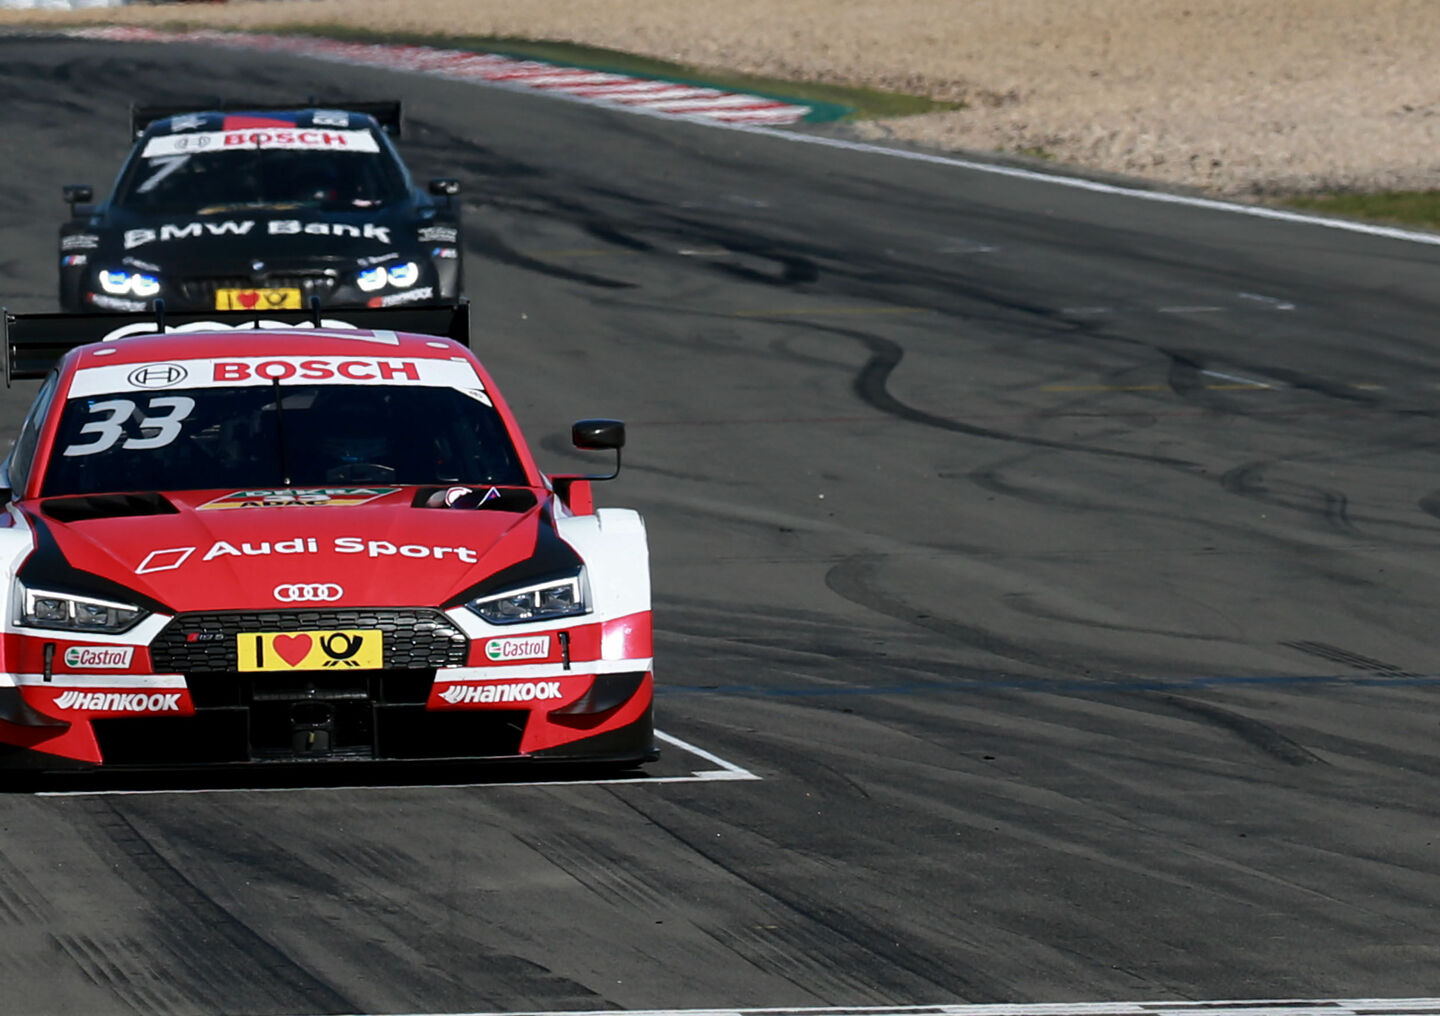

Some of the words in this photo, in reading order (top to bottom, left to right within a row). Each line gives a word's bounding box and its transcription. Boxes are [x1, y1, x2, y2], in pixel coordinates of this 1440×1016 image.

[224, 131, 347, 147] BOSCH
[136, 155, 191, 194] 7
[124, 220, 255, 249] BMW
[267, 220, 391, 244] Bank
[213, 360, 421, 382] BOSCH
[63, 396, 196, 457] 33
[202, 538, 318, 561] Audi
[334, 537, 478, 564] Sport
[80, 648, 128, 666] Castrol
[503, 640, 545, 657] Castrol
